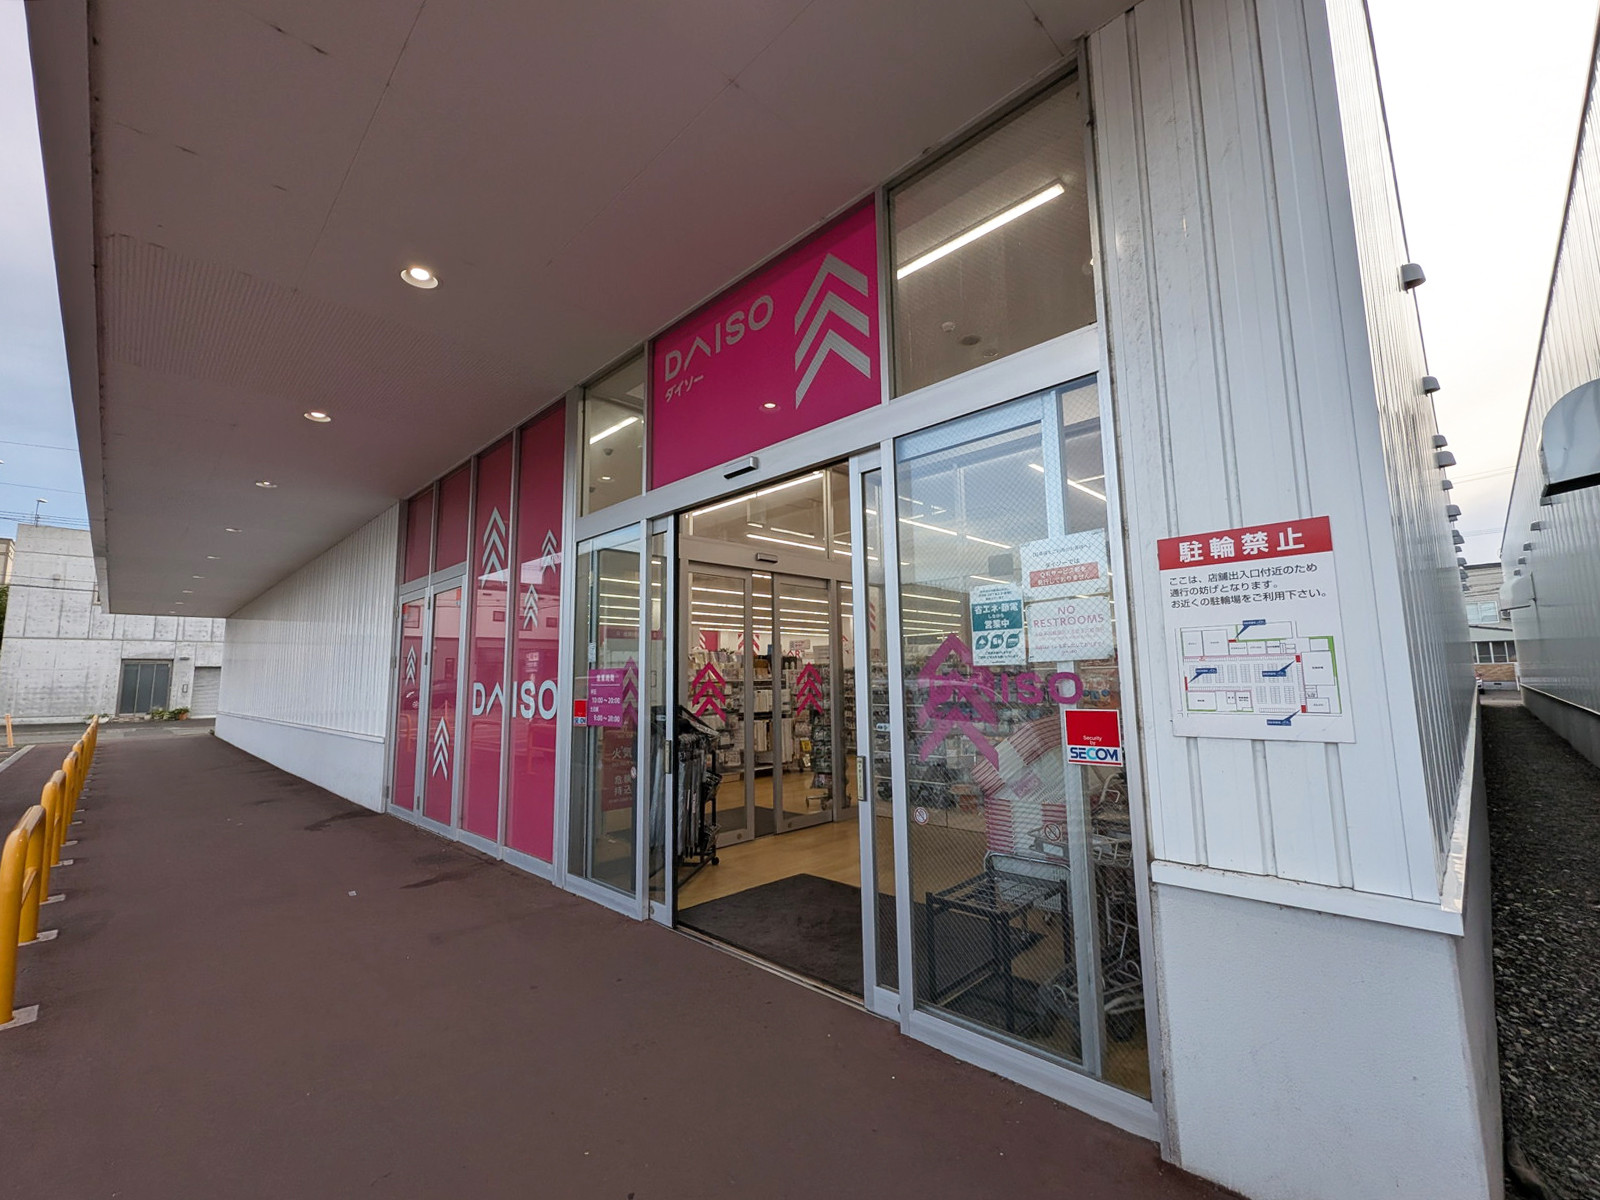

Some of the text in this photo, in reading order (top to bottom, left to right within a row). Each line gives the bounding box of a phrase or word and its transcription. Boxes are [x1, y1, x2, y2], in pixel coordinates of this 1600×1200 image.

[665, 295, 774, 382] DAISO
[665, 375, 704, 402] ダイソー
[1178, 527, 1304, 563] 駐輪禁止
[1169, 563, 1317, 586] ここは、店舗出入口付近のため
[1170, 580, 1278, 598] 通行の妨げとなります。
[1171, 588, 1326, 609] お近くの駐輪場をご利用下さい。
[1057, 605, 1075, 615] NO
[984, 619, 1010, 629] 営業中
[1033, 614, 1104, 628] RESTROOMS
[472, 680, 558, 720] DAISO
[1082, 735, 1102, 743] Security
[1070, 747, 1118, 761] SECOM
